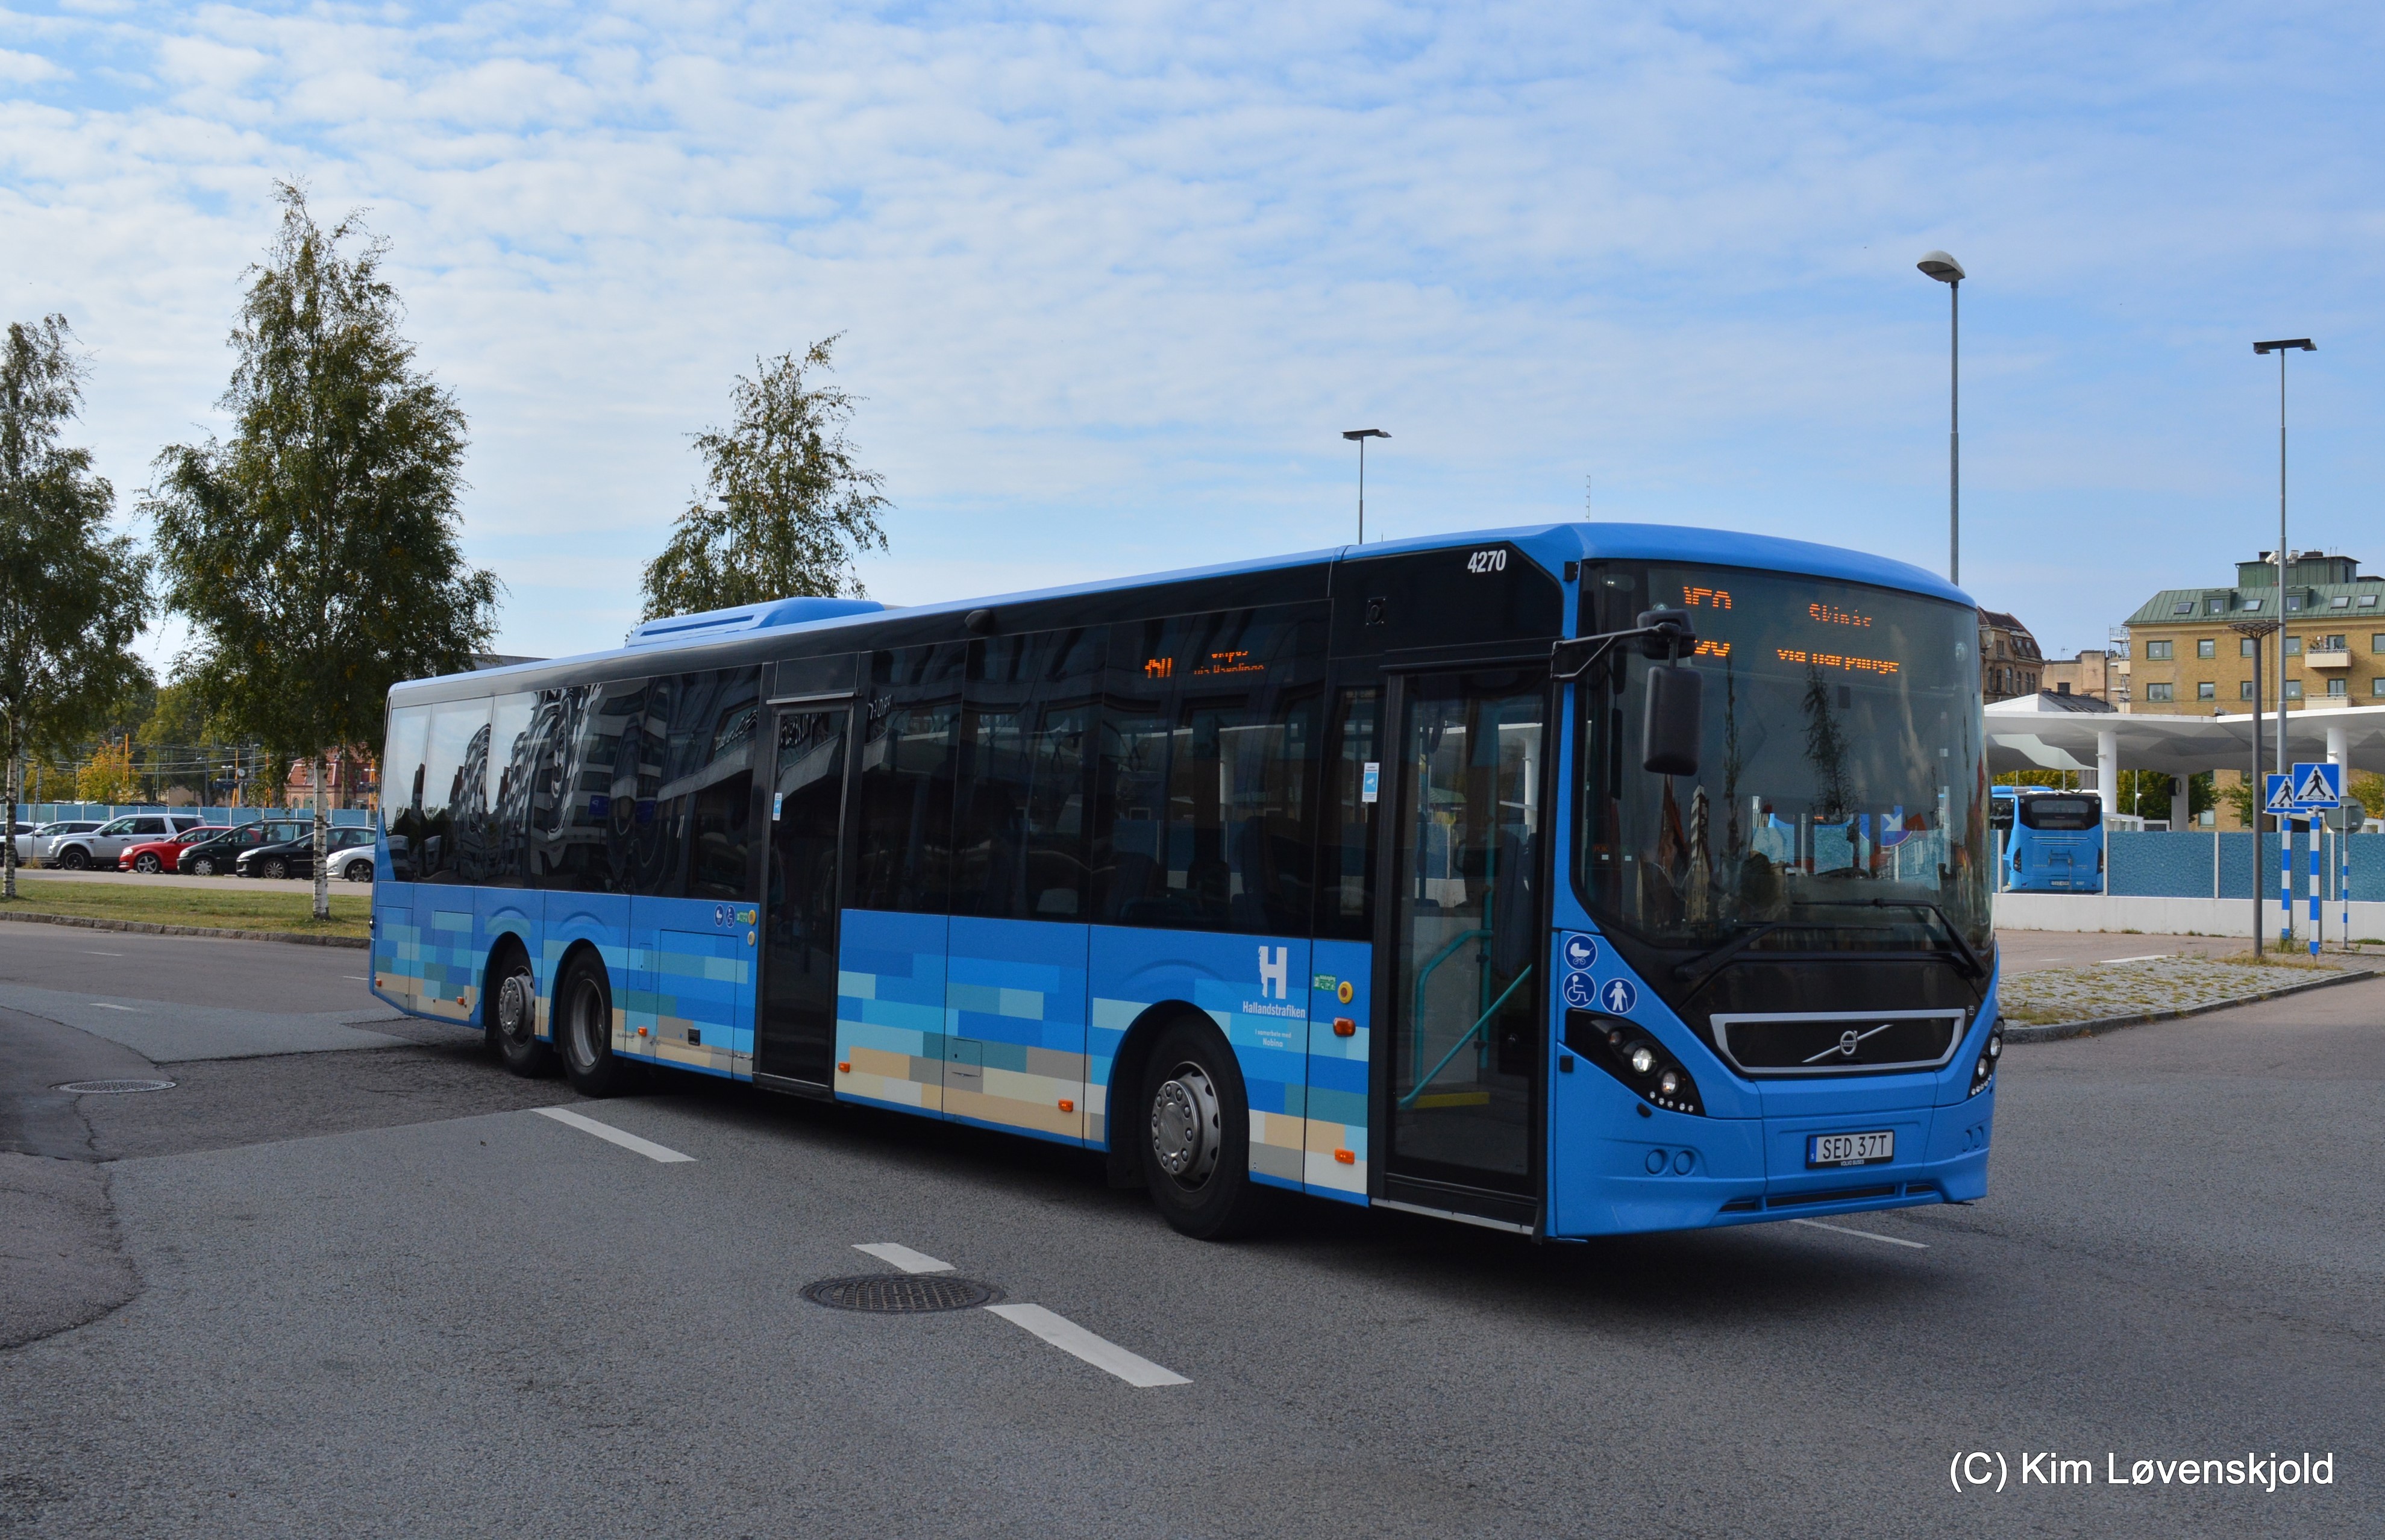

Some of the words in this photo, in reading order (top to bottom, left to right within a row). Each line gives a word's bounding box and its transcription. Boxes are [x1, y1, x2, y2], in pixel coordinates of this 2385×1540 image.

[1467, 549, 1506, 573] 4270
[1258, 945, 1287, 1000] H
[1243, 1001, 1306, 1018] Hallandstrafiken
[1262, 1038, 1283, 1047] Nobina
[1823, 1138, 1852, 1159] SED
[1858, 1135, 1887, 1156] 37T
